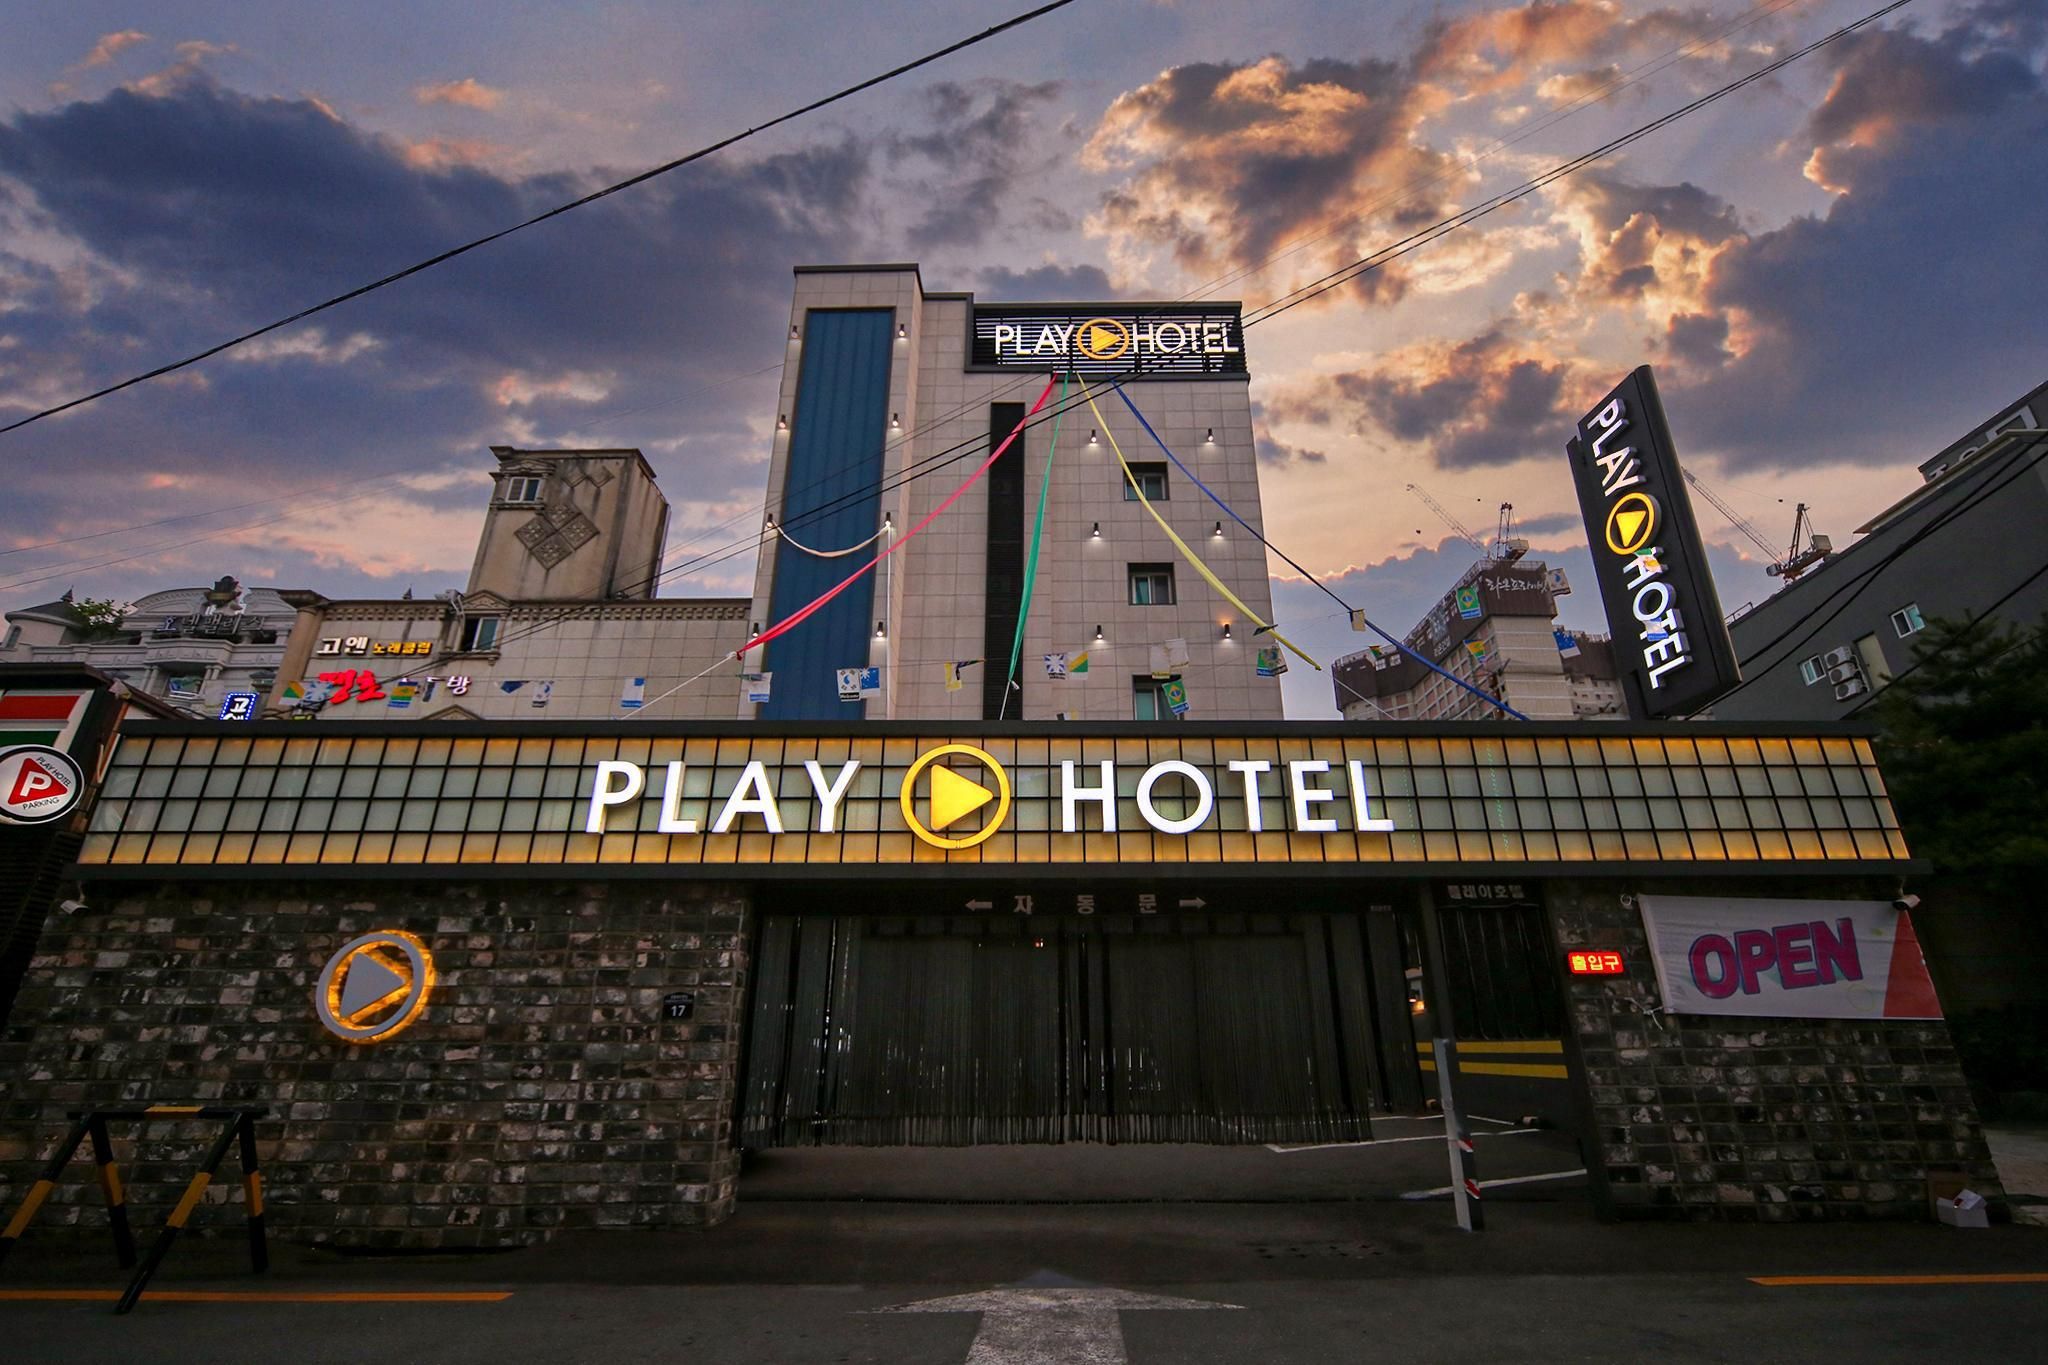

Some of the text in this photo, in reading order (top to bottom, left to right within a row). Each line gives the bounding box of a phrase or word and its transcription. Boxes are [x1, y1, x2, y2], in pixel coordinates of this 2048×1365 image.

[995, 322, 1239, 355] PLAY HOTEL
[1587, 398, 1688, 690] PLAY HOTEL
[316, 636, 369, 655] 고엔
[20, 770, 53, 798] P
[36, 756, 72, 788] PLAY HOTEL
[22, 796, 60, 810] PARKING
[585, 759, 1396, 834] PLAY HOTEL
[1013, 894, 1157, 916] 자동문
[1688, 917, 1864, 1000] OPEN
[671, 1004, 687, 1017] 17
